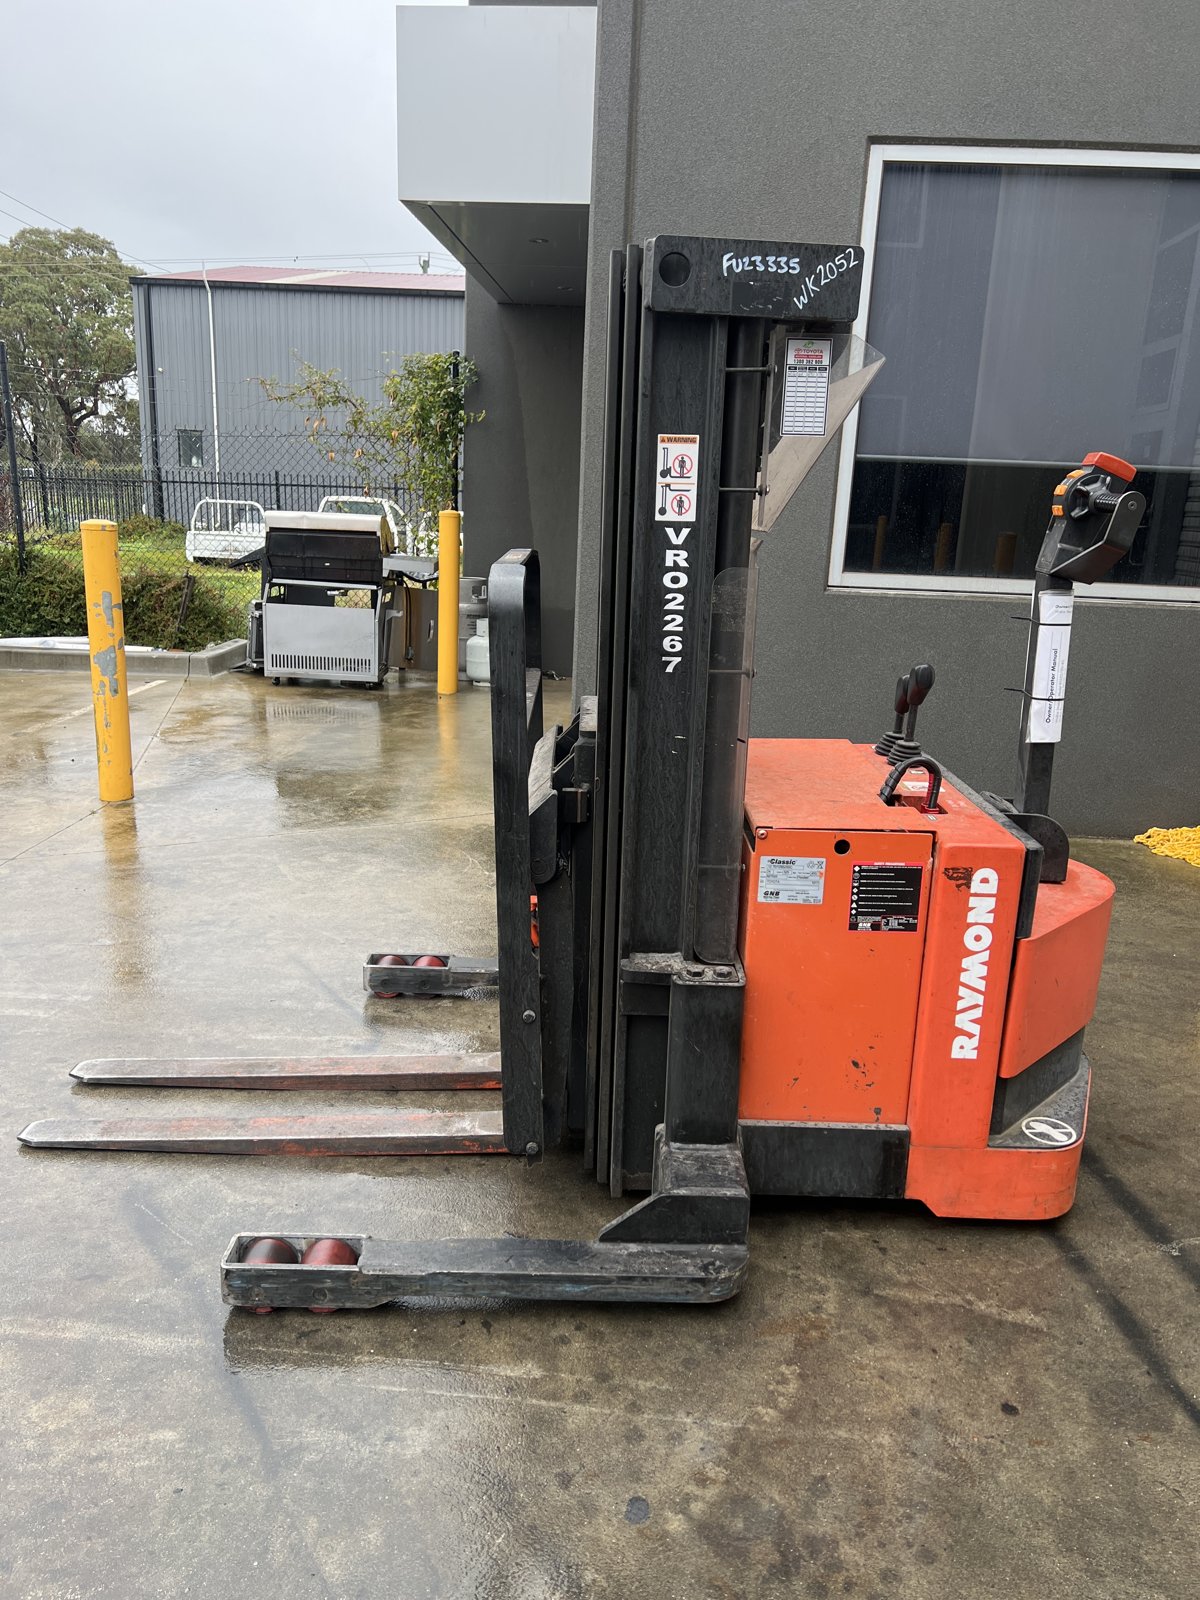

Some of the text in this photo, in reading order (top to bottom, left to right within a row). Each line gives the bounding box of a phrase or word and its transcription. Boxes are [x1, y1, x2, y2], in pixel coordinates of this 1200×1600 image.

[722, 252, 801, 277] FU23335
[793, 247, 859, 310] WK2052
[1050, 648, 1058, 672] Manual
[950, 867, 999, 1060] RAYMOND
